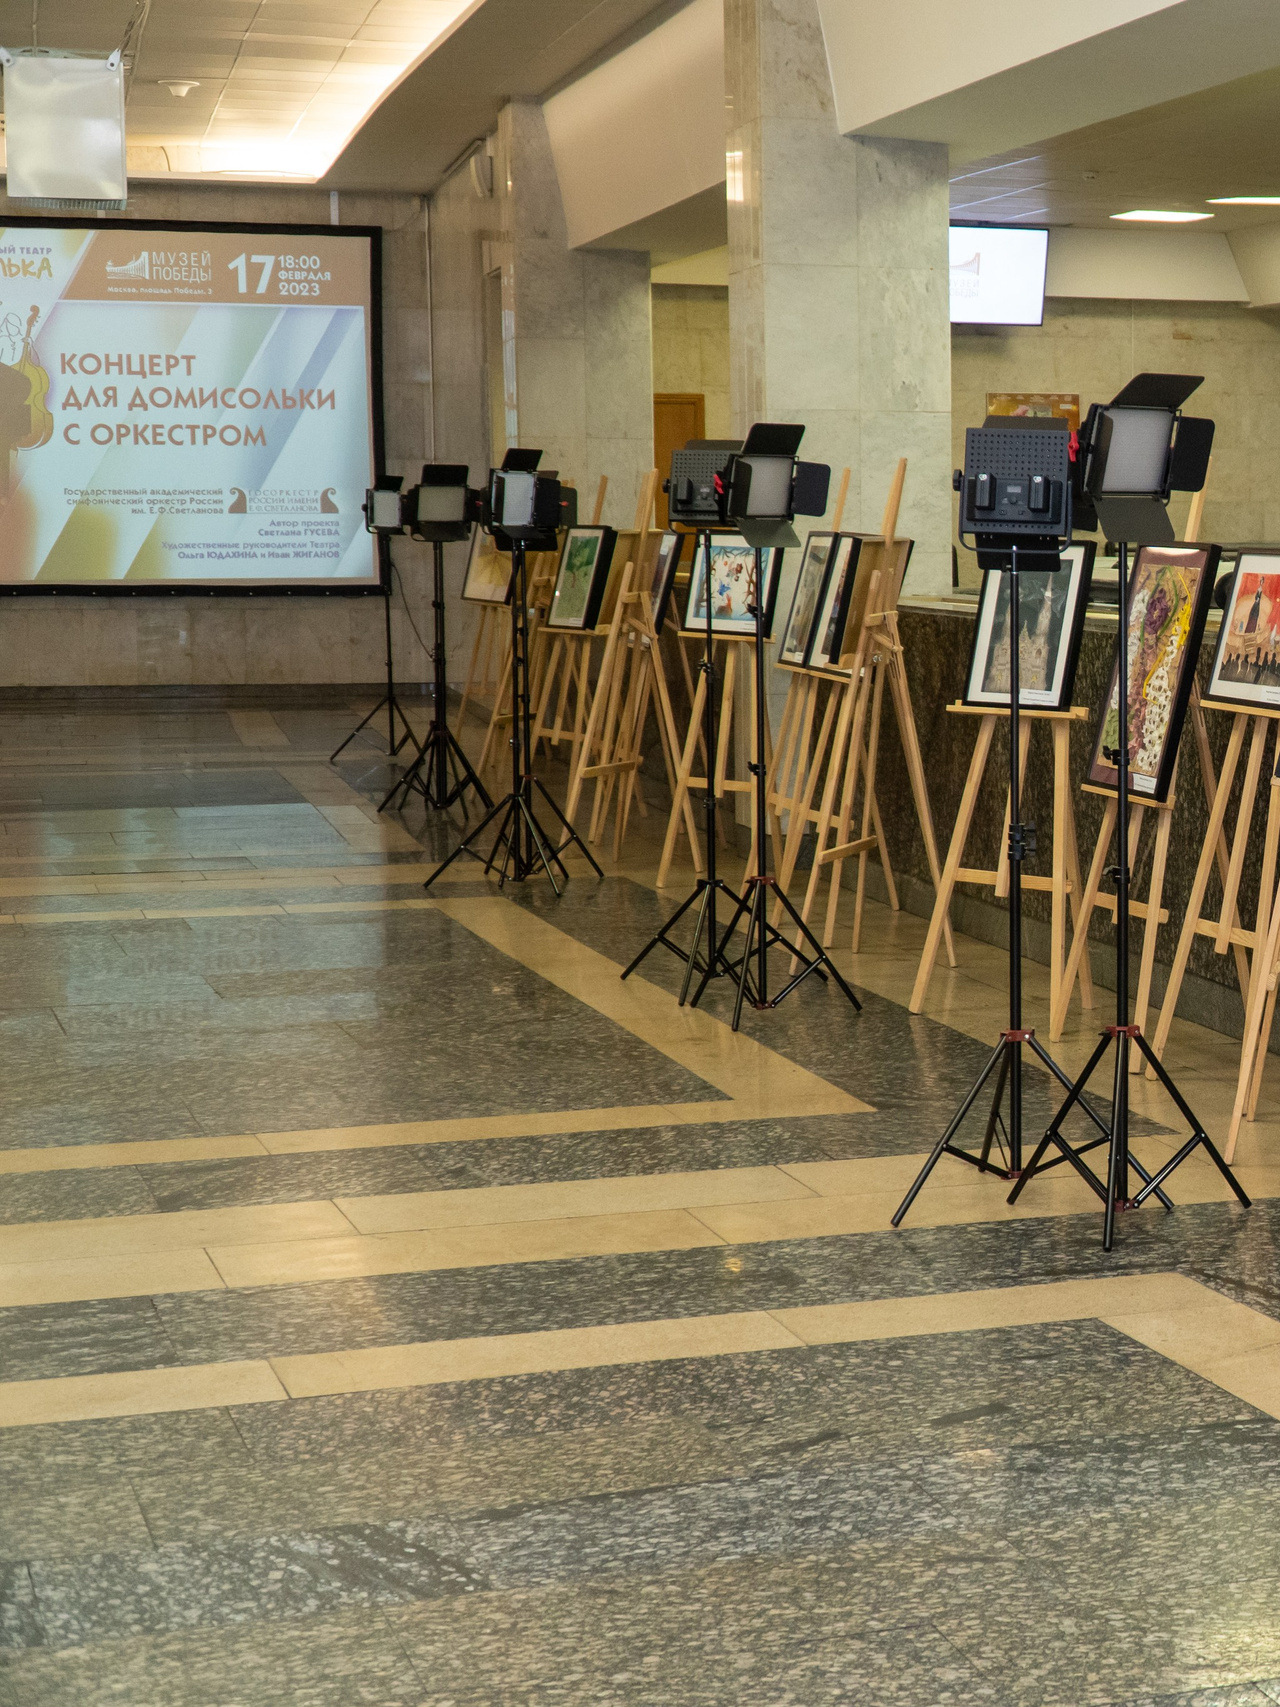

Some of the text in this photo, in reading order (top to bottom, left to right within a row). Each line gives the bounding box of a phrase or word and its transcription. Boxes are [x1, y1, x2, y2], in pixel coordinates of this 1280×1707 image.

[19, 246, 52, 255] ТЕАТР
[152, 250, 211, 266] МУЗЕЙ
[277, 255, 320, 270] 18:00
[153, 267, 212, 284] ПОБЕДЫ
[227, 252, 276, 294] 17
[277, 270, 331, 281] ФЕВРАЛЯ
[278, 282, 321, 296] 2023
[60, 352, 196, 379] КОНЦЕРТ
[61, 385, 336, 411] ДЛЯ ДОМИСОЛЬКИ
[62, 423, 266, 447] С ОРКЕСТРОМ
[63, 487, 223, 497] Государственный академический
[248, 489, 319, 497] ГОСОРКЕСТР
[66, 497, 223, 506] симфонический оркестр России
[269, 519, 340, 528] Автор проекта
[161, 541, 340, 550] Художественные руководители Театра
[178, 551, 205, 559] Ольга
[207, 551, 258, 559] ЮДАХИНА
[292, 551, 340, 559] ЖИГАНОВ
